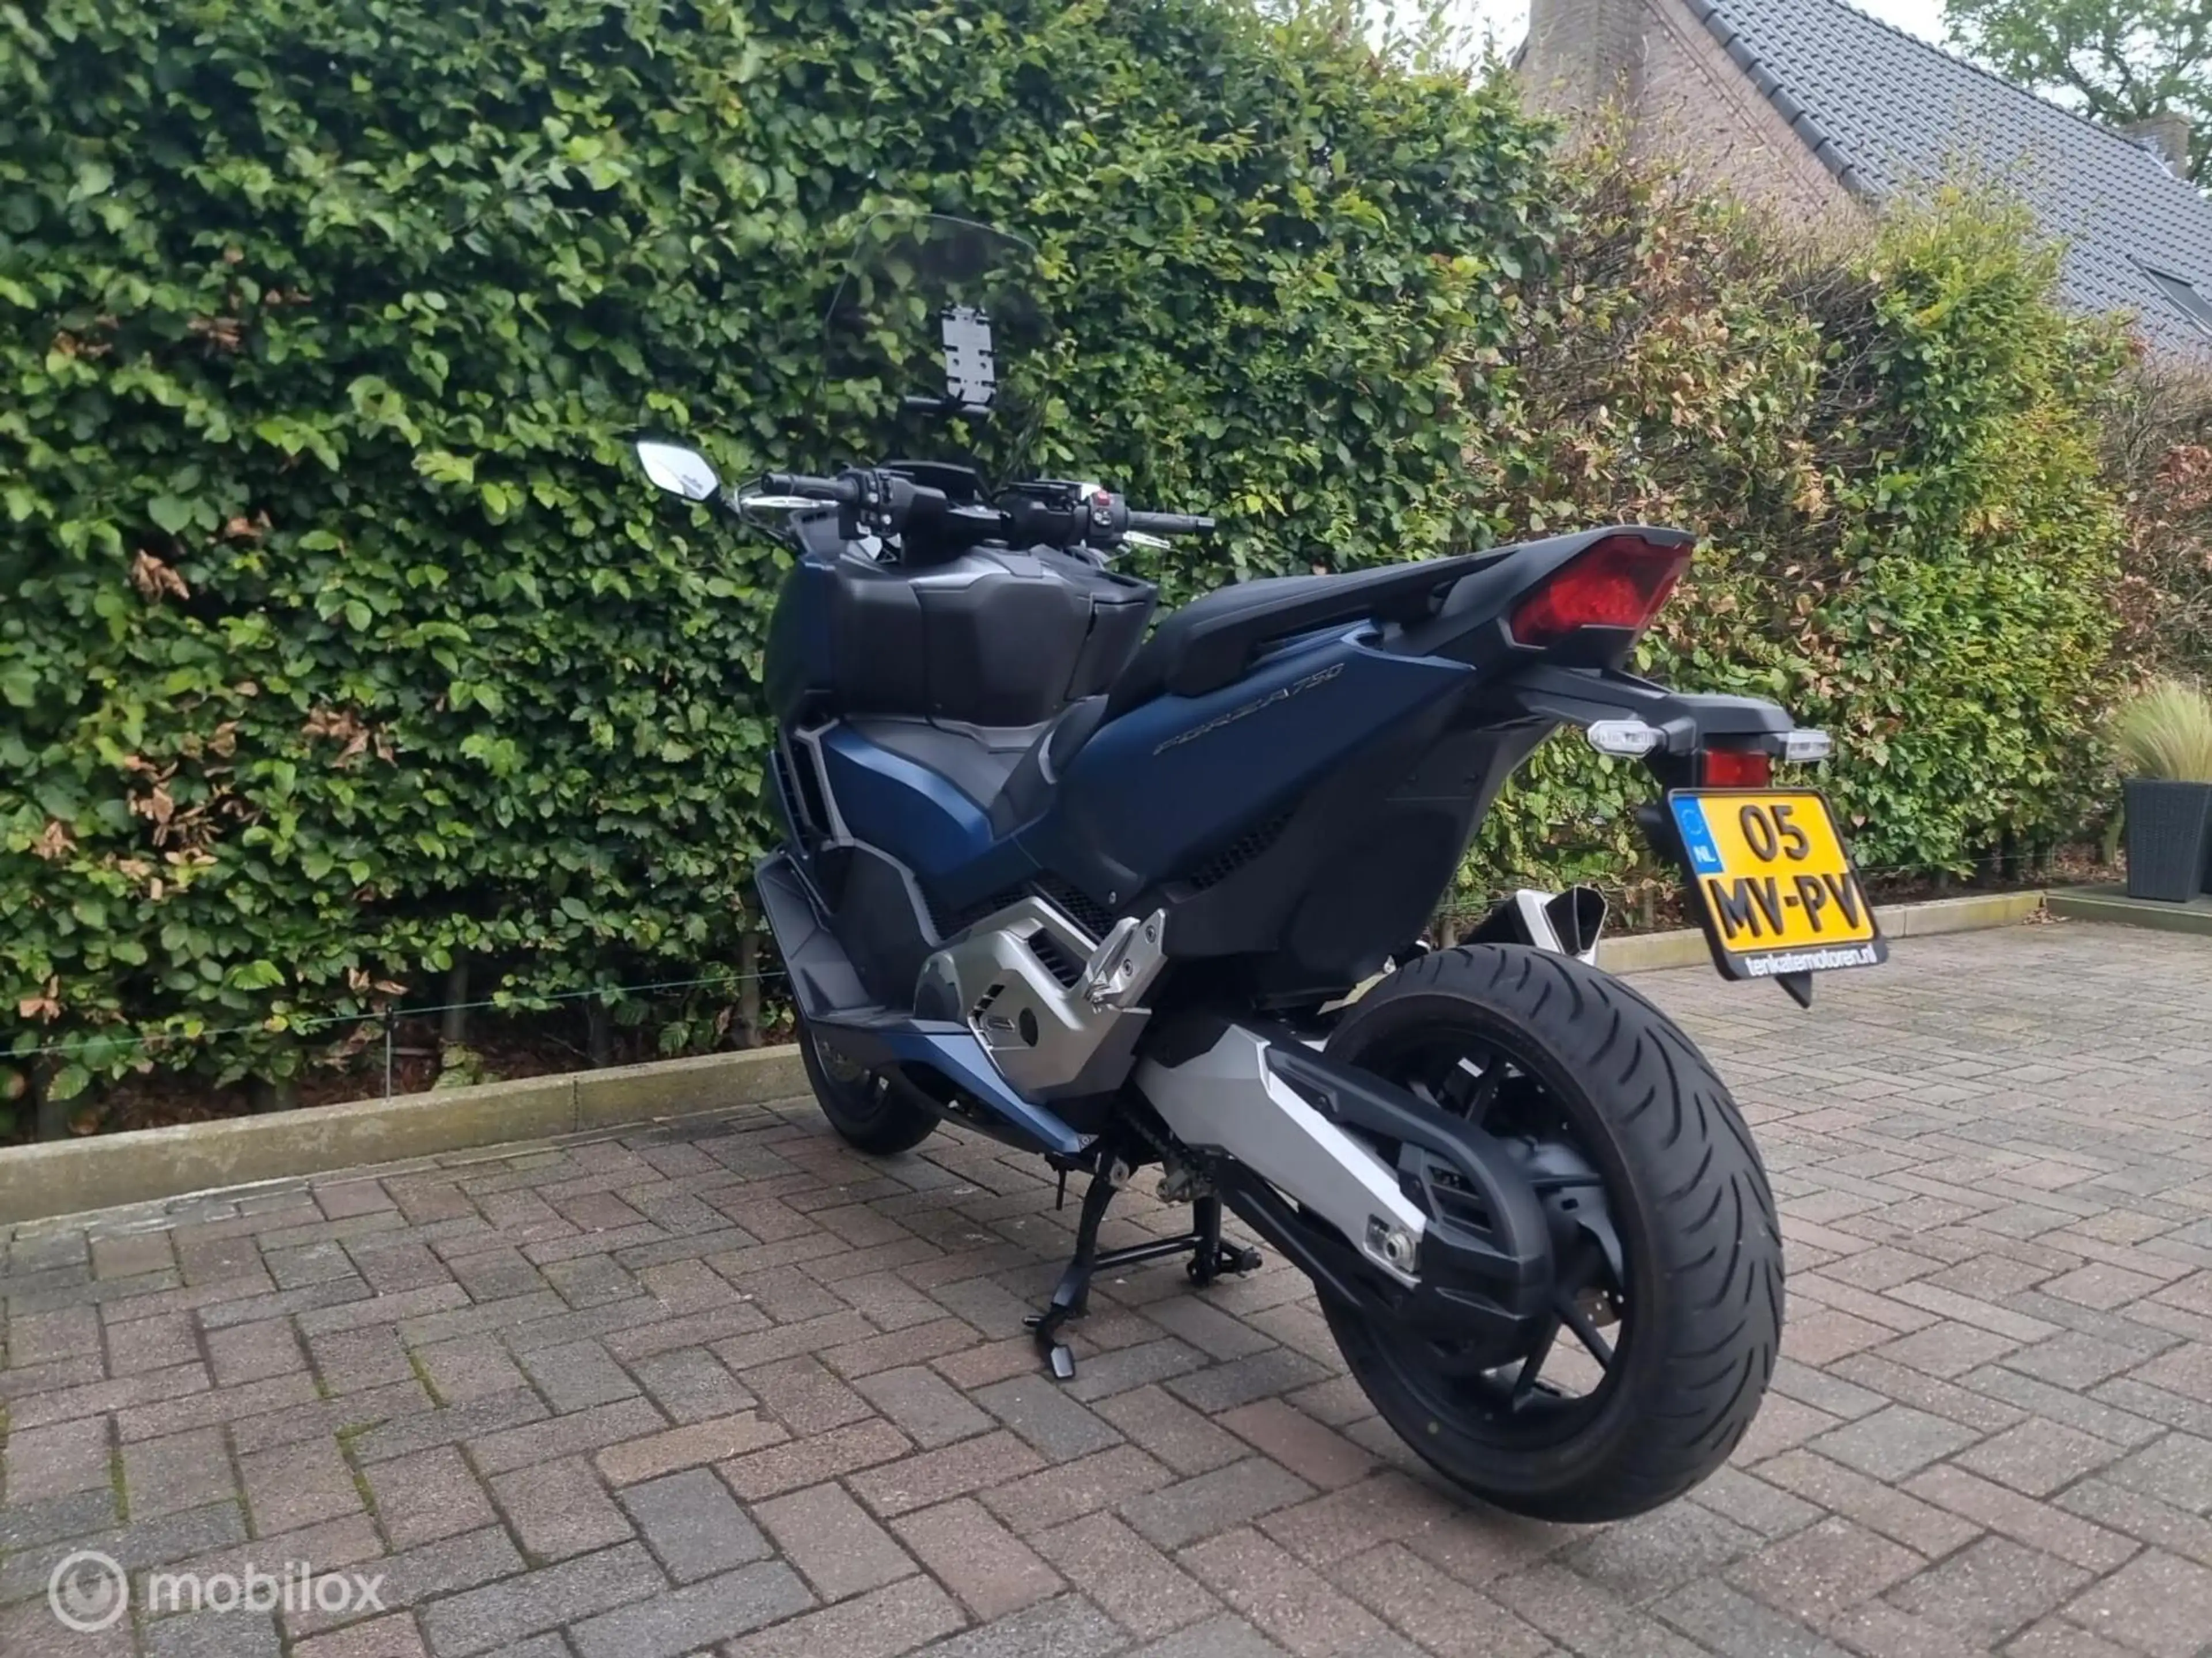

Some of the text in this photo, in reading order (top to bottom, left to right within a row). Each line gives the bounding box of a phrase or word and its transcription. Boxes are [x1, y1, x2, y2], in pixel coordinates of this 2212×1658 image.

[1693, 845, 1717, 863] NL
[1739, 804, 1810, 862] 05
[1707, 872, 1860, 940] MV-PV
[1744, 942, 1878, 976] tenkatemotoren.nl
